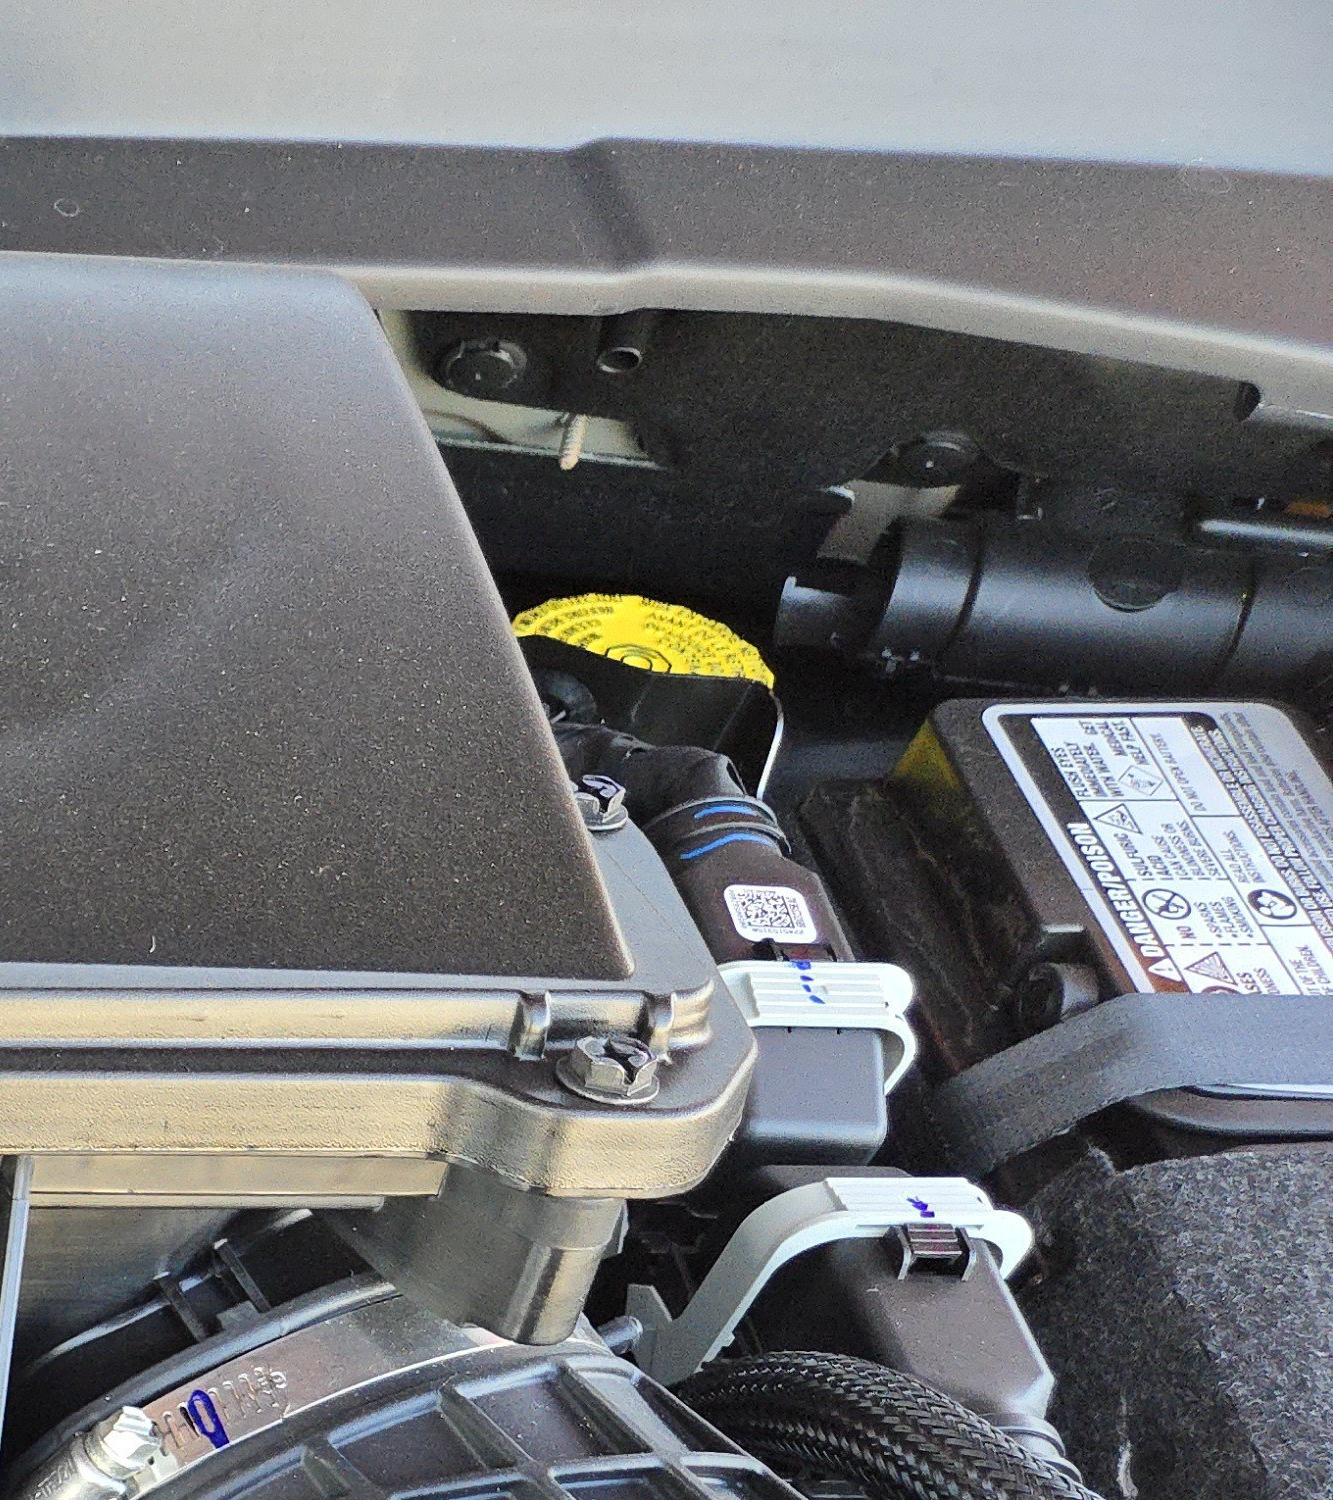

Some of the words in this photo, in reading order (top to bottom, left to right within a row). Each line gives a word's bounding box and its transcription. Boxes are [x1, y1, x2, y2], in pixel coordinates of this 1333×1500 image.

[1095, 721, 1126, 756] MEDICAL
[1051, 747, 1073, 767] EYES
[1065, 741, 1107, 796] IMMEDIATELY
[1126, 745, 1148, 764] HELP
[1065, 771, 1090, 796] FLUSH
[1102, 776, 1123, 796] WITH
[1114, 832, 1152, 876] SULFURIC
[1148, 855, 1171, 875] ACID
[1066, 822, 1165, 956] DANGER/POISON
[1209, 901, 1237, 932] FLAMES
[1221, 896, 1253, 932] SMOKING
[1176, 925, 1196, 938] NO
